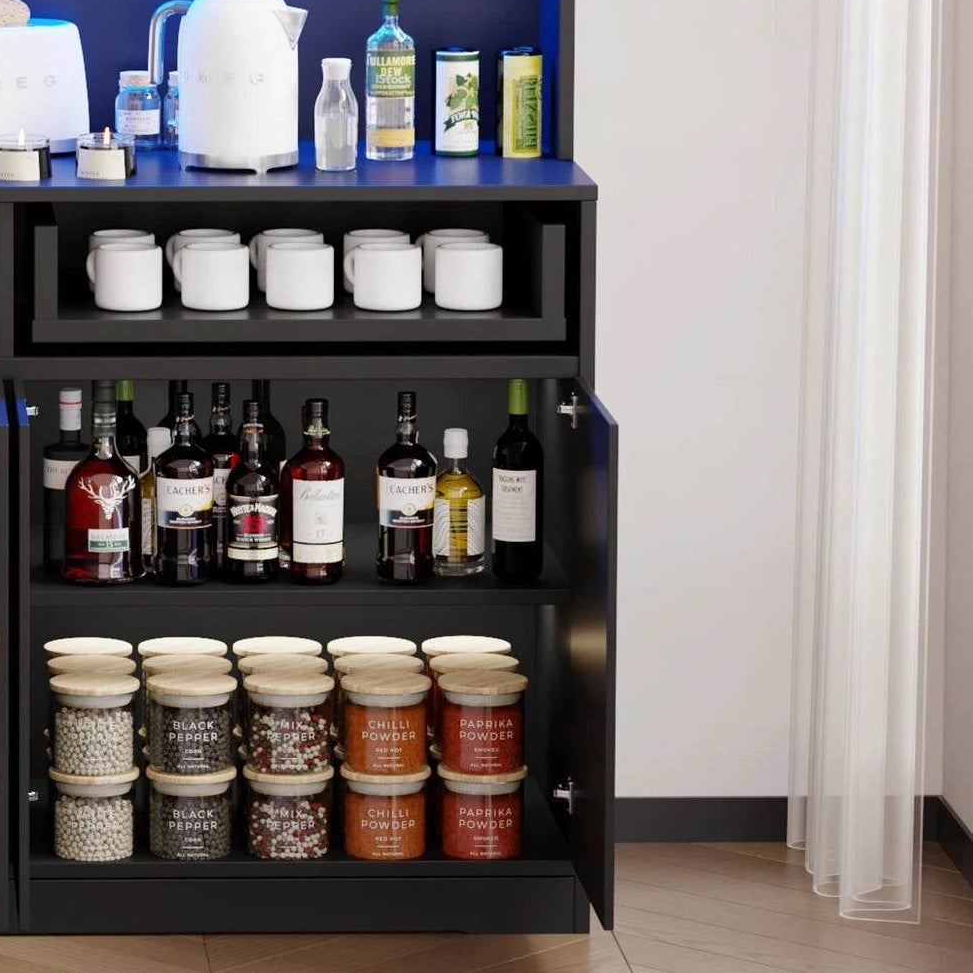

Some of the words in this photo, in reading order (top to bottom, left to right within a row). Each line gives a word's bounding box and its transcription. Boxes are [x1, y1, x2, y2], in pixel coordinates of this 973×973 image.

[366, 53, 416, 66] TULLAMORE
[380, 66, 402, 77] DEW
[172, 721, 214, 730] BLACK
[280, 721, 303, 730] MIX
[367, 720, 410, 729] CHILLI
[459, 719, 513, 729] PAPRIKA
[168, 732, 218, 742] PEPPER
[266, 732, 315, 741] PEPPER
[361, 731, 416, 742] POWDER
[459, 730, 514, 741] POWDER
[172, 809, 214, 819] BLACK
[280, 809, 303, 819] MIX
[367, 808, 409, 818] CHILLI
[459, 807, 512, 817] PAPRIKA
[168, 820, 218, 831] PEPPER
[266, 821, 315, 831] PEPPER
[361, 819, 416, 830] POWDER
[458, 819, 513, 829] POWDER
